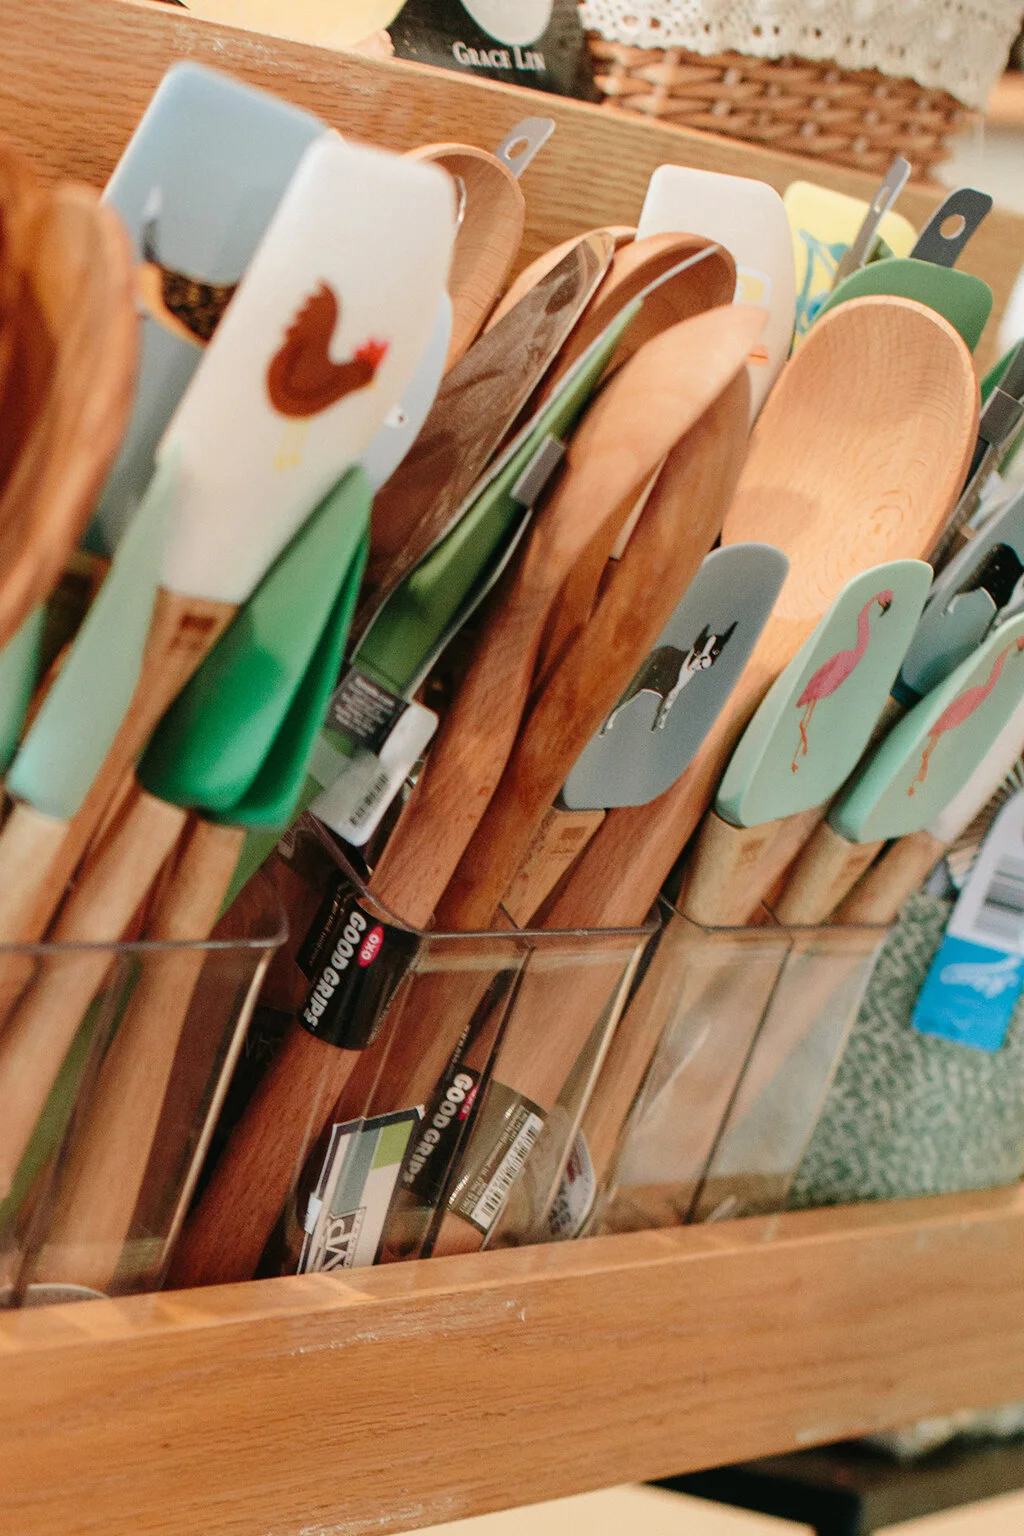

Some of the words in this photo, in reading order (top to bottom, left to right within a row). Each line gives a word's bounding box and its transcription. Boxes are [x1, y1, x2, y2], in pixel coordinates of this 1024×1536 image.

[452, 40, 513, 69] GRACE
[513, 46, 546, 71] LIN
[331, 911, 367, 971] GOOD
[360, 933, 381, 961] OXO
[303, 966, 340, 1028] GRIPS
[432, 1073, 474, 1129] GOOD
[402, 1129, 441, 1185] GRIPS
[322, 1218, 353, 1271] VP
